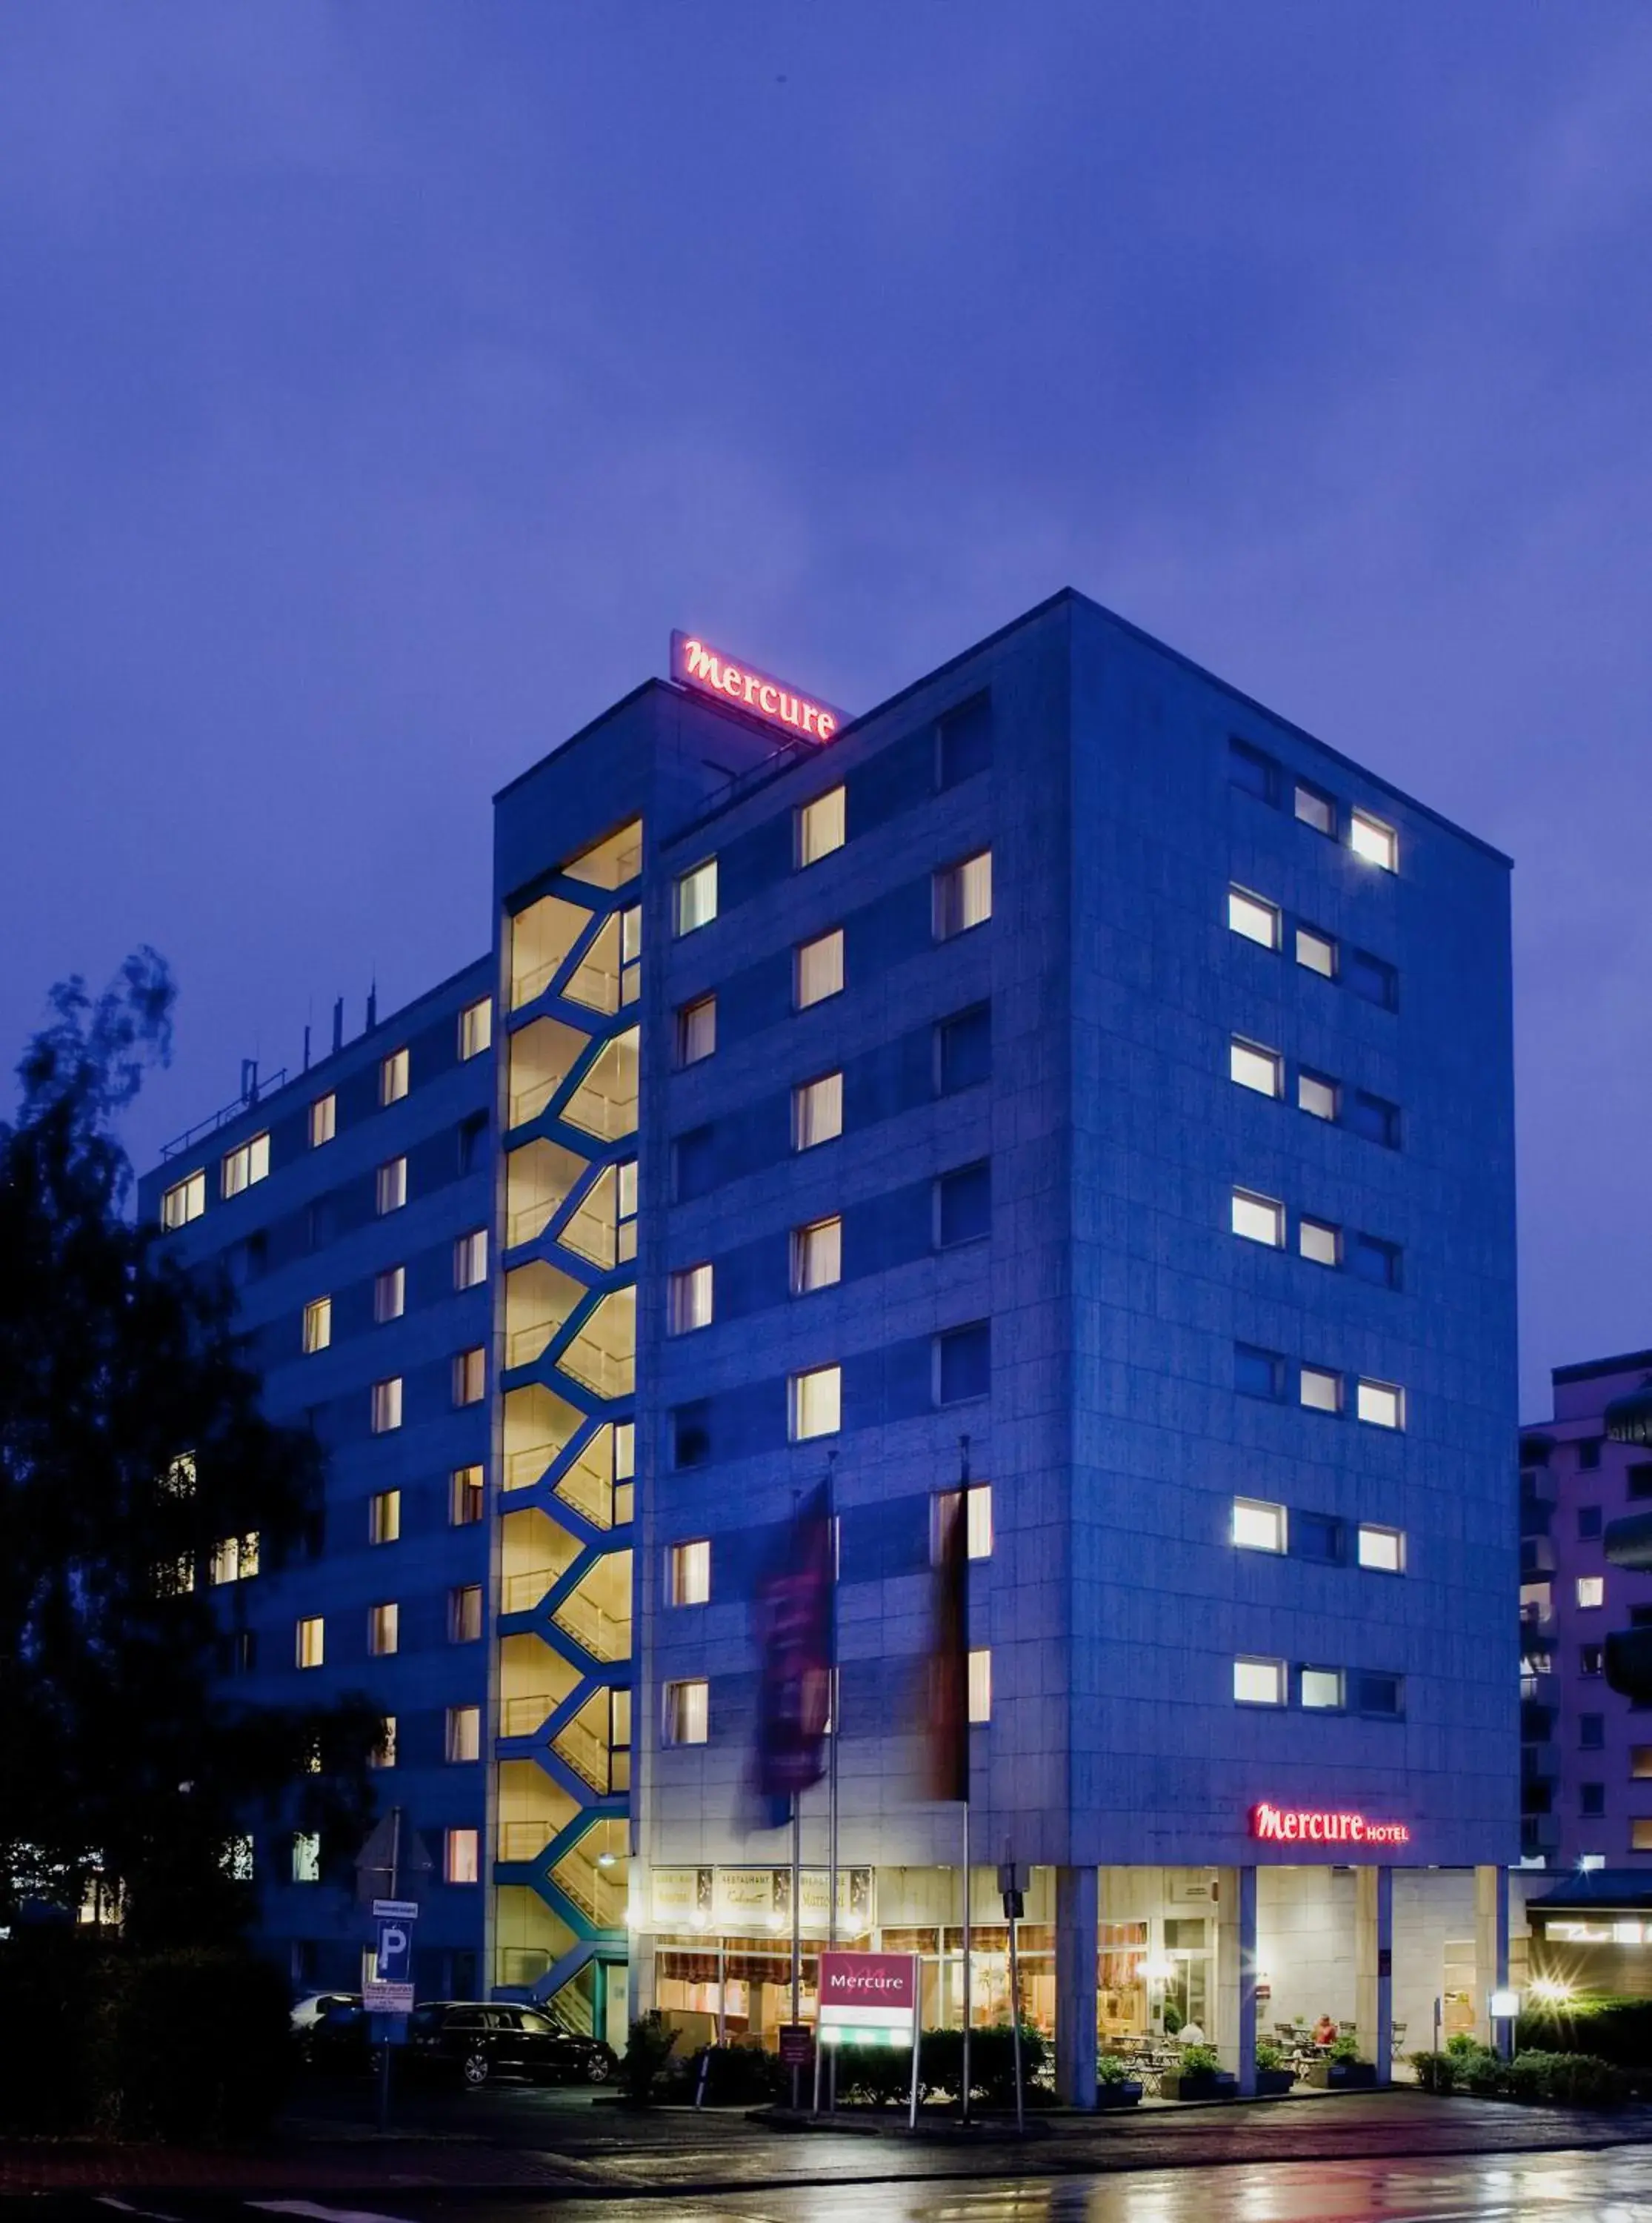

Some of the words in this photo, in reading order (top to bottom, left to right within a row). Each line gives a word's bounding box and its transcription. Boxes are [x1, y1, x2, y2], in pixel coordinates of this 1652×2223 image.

[685, 639, 836, 740] Mercure
[1257, 1804, 1363, 1840] Mercure
[1367, 1827, 1410, 1841] HOTEL
[379, 1928, 407, 1970] P
[830, 1974, 904, 1990] Mercure
